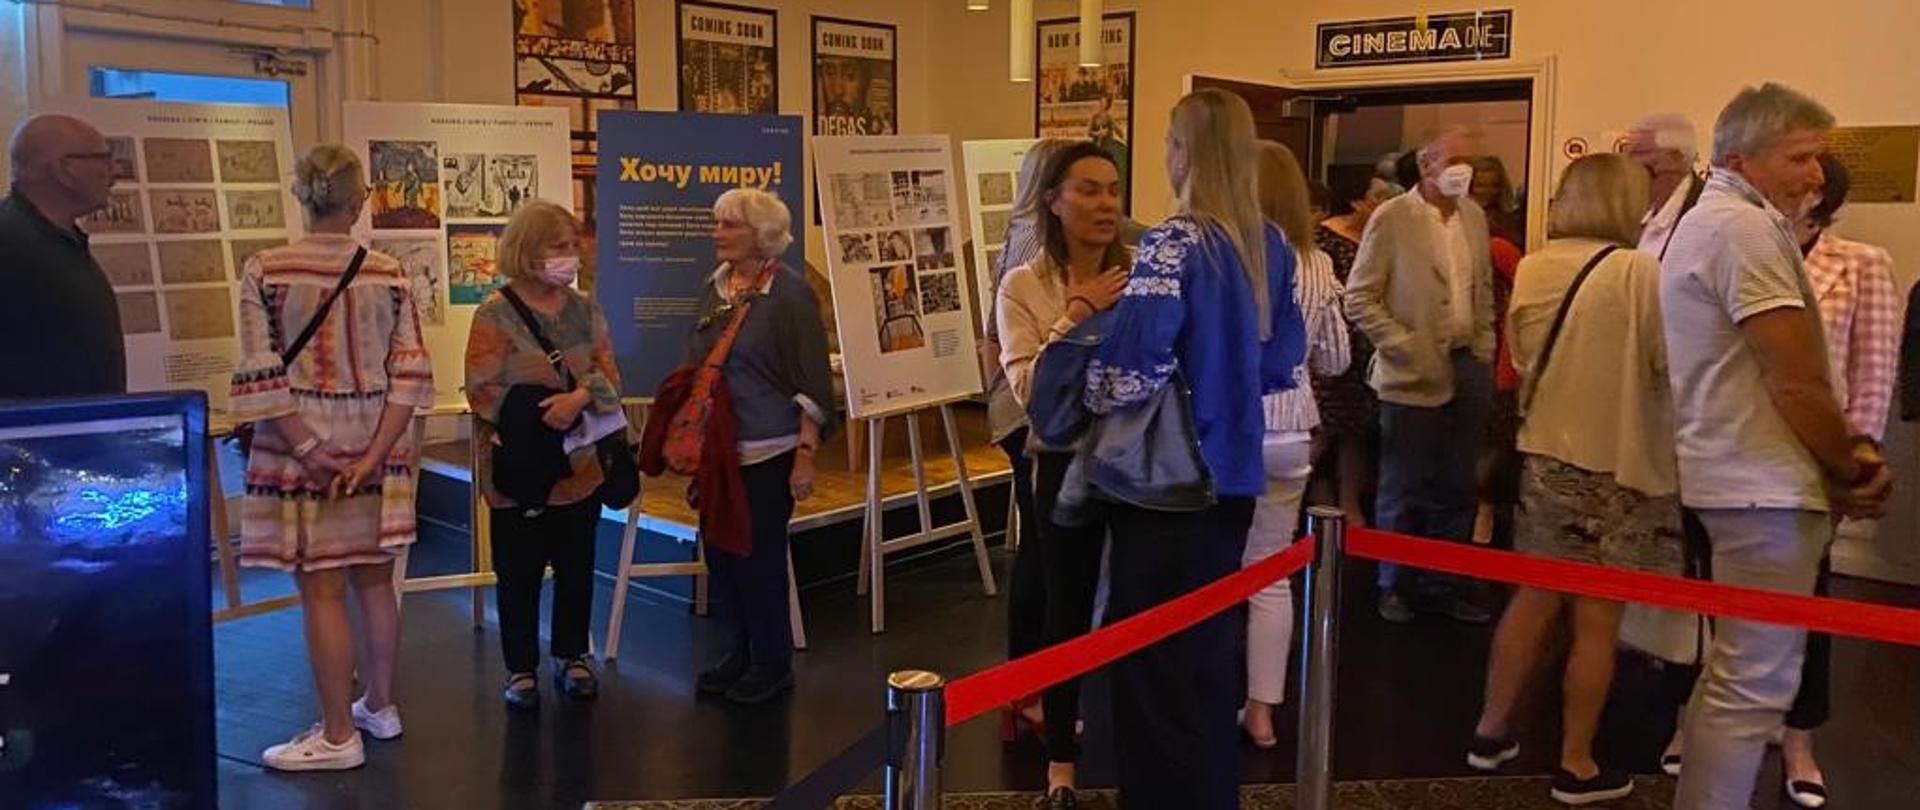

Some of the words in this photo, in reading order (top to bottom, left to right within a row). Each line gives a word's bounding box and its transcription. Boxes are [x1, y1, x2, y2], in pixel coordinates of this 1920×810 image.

[690, 15, 732, 37] COMING
[737, 22, 764, 40] SOON
[822, 31, 857, 49] COMING
[861, 36, 885, 51] SOON
[1048, 33, 1070, 48] NOW
[1329, 27, 1461, 57] CINEMA
[1465, 24, 1495, 49] ONE
[818, 115, 867, 136] DEGAS
[619, 157, 692, 190] Хочу
[699, 161, 782, 191] миру!
